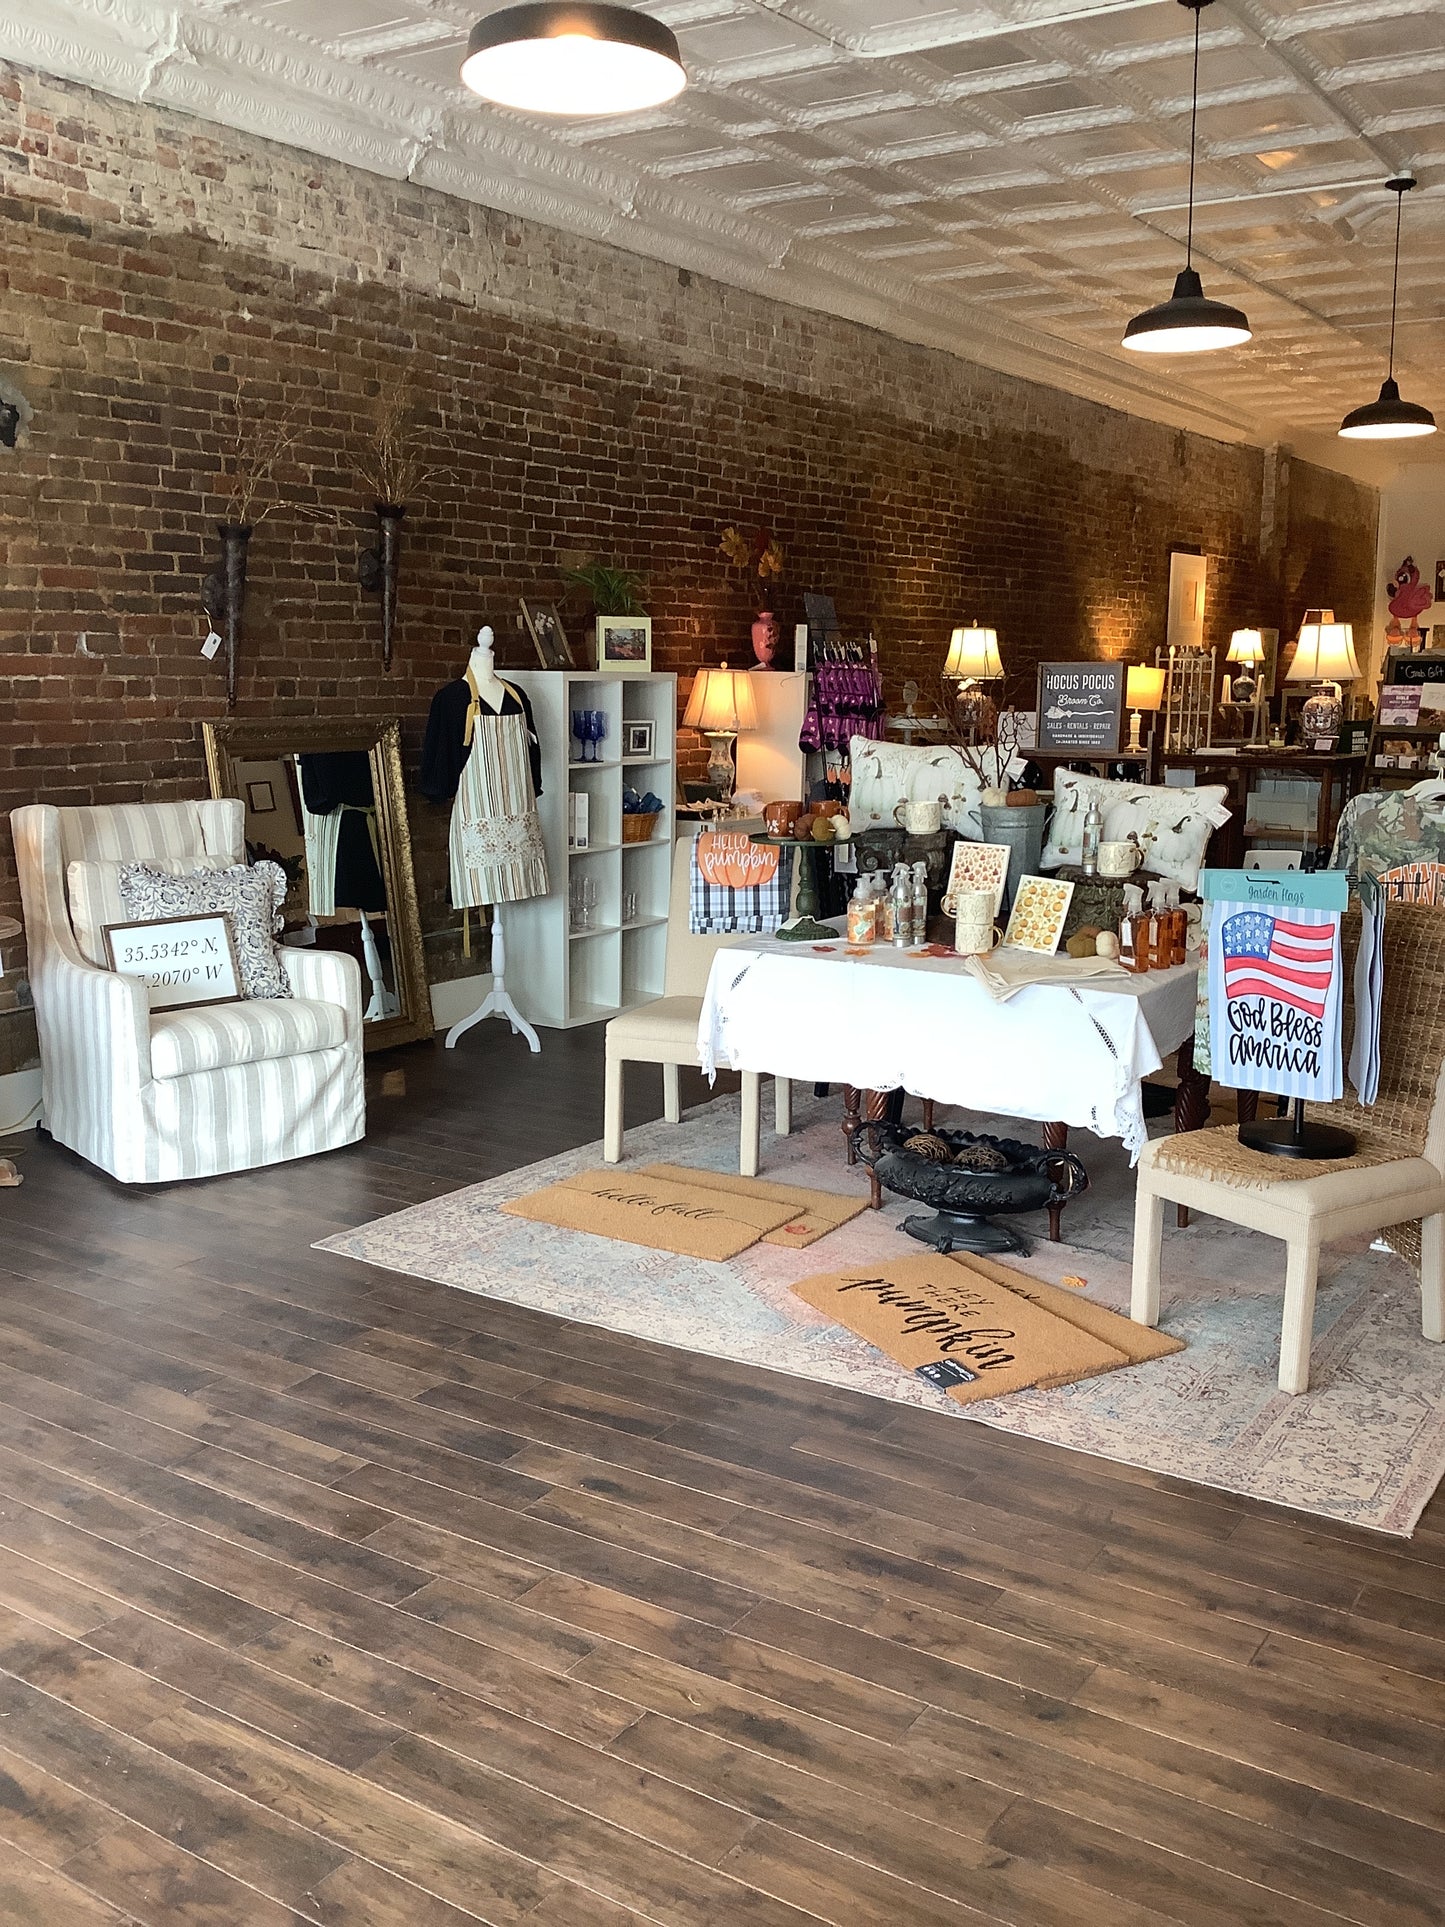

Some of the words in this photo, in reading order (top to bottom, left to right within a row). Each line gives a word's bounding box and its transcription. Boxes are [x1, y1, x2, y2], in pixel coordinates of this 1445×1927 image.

[1046, 674, 1079, 690] HOCUS
[1082, 674, 1115, 690] POCUS
[1057, 694, 1088, 706] Broom
[1046, 722, 1062, 730] SALES
[1067, 722, 1089, 730] RENTALS
[1093, 722, 1111, 730] REPAIR
[711, 834, 748, 851] HELLO
[704, 843, 777, 877] pumpkin
[1248, 886, 1278, 900] garden
[1281, 888, 1305, 906] flags
[123, 940, 198, 963] 35.5342°
[201, 936, 219, 955] N,
[138, 967, 200, 989] 7.2070°
[205, 964, 224, 981] W
[1227, 997, 1267, 1032] God
[1270, 1001, 1323, 1048] Bless
[591, 1188, 657, 1206] hello
[651, 1202, 725, 1220] fall
[916, 1283, 981, 1318] THERE
[948, 1285, 996, 1306] HEY
[836, 1277, 1016, 1371] pumpkin
